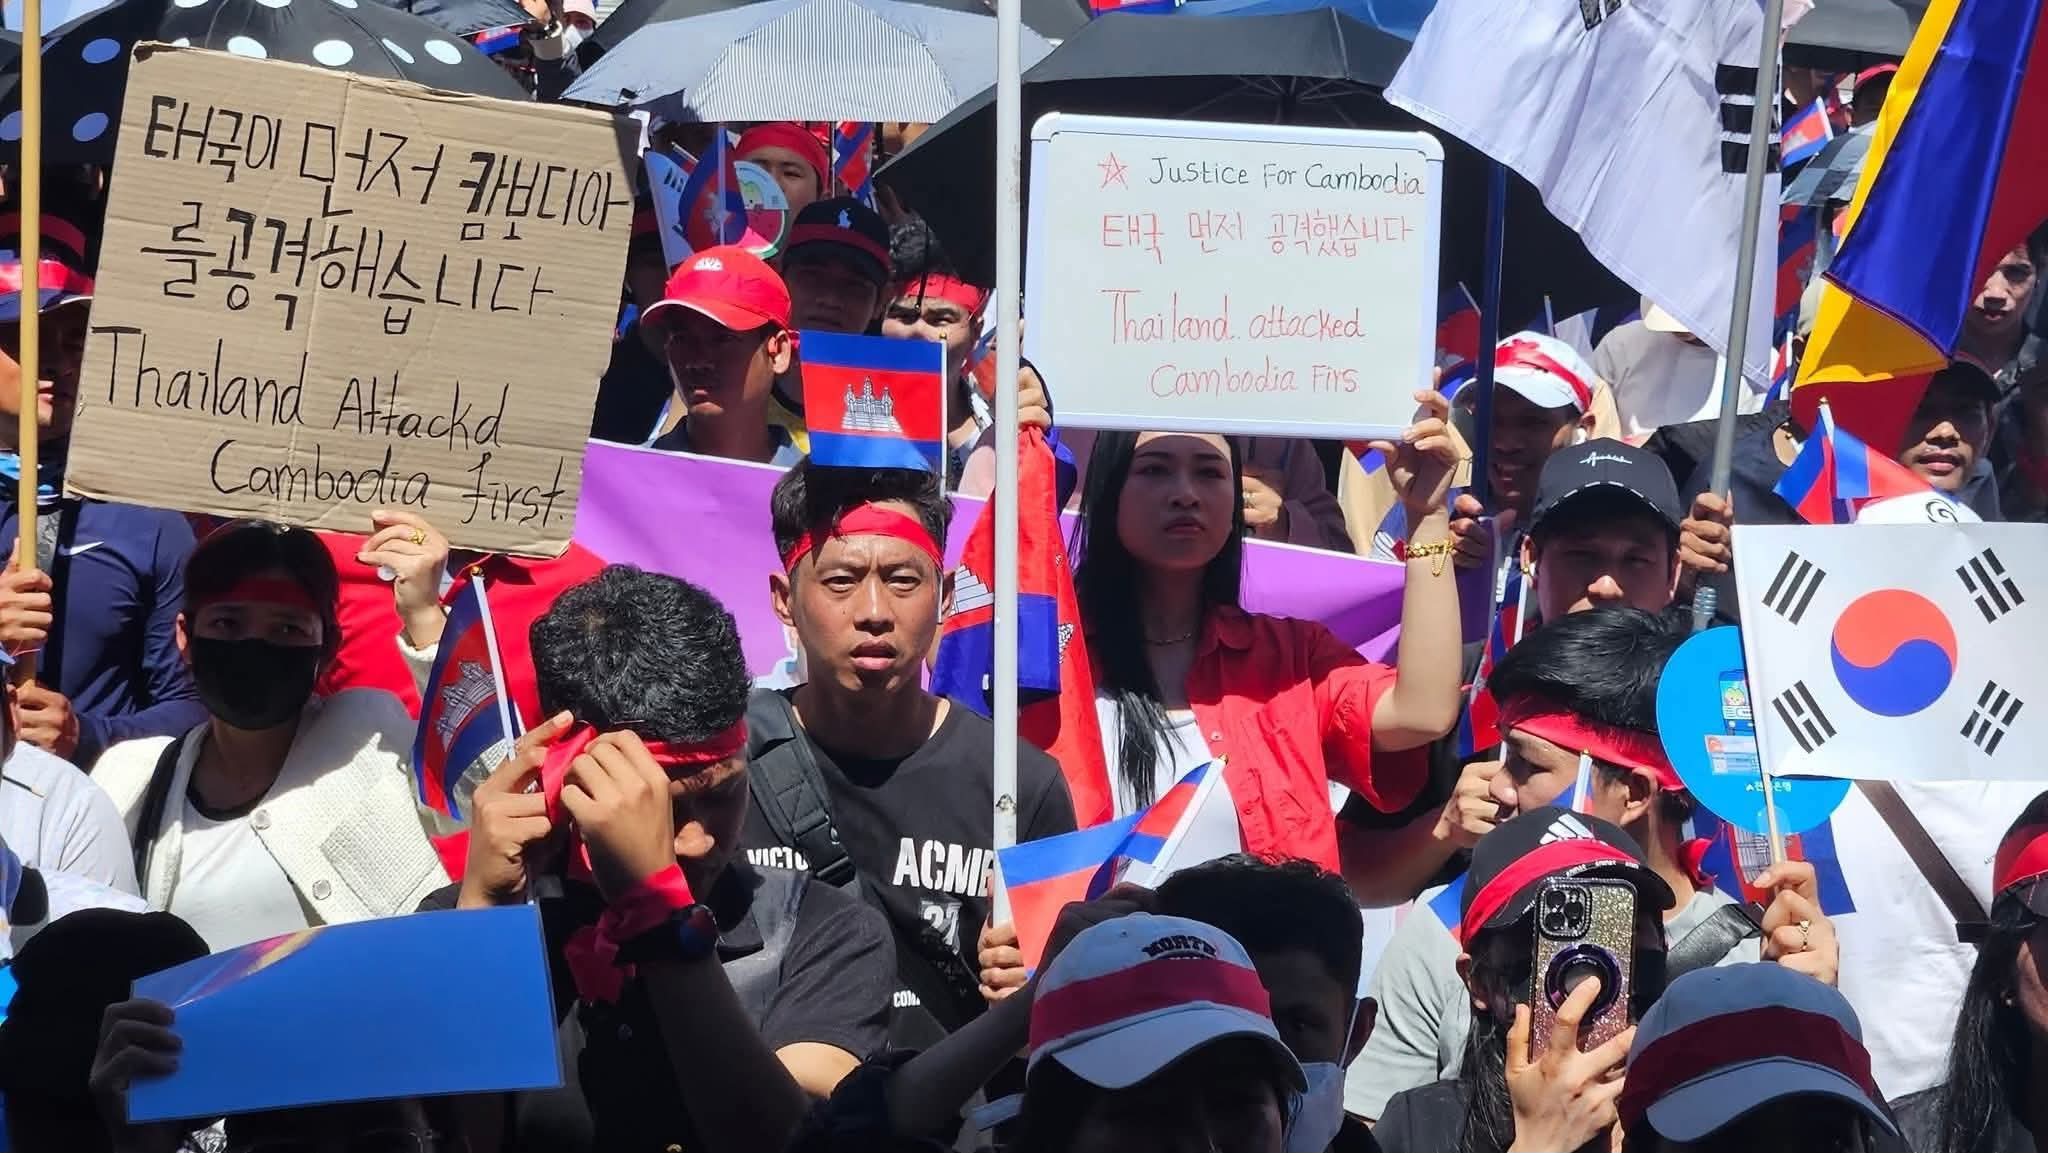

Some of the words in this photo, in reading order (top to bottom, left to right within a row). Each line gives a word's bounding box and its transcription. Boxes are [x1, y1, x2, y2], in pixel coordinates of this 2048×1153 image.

[144, 95, 282, 183] 태국이
[299, 122, 445, 218] 먼저
[459, 151, 630, 241] 캄보디아
[1149, 157, 1249, 185] Justice
[1263, 163, 1297, 189] For
[1304, 161, 1425, 195] Cambodia
[1103, 212, 1165, 265] 태국
[1188, 210, 1244, 254] 먼저
[1267, 208, 1415, 258] 공격했습니다
[1249, 303, 1366, 342] attacked
[91, 326, 309, 426] Thailand
[332, 369, 510, 452] Attackd
[1150, 354, 1297, 399] Cambodia
[1312, 364, 1360, 394] Firs
[211, 439, 430, 509] Cambodia
